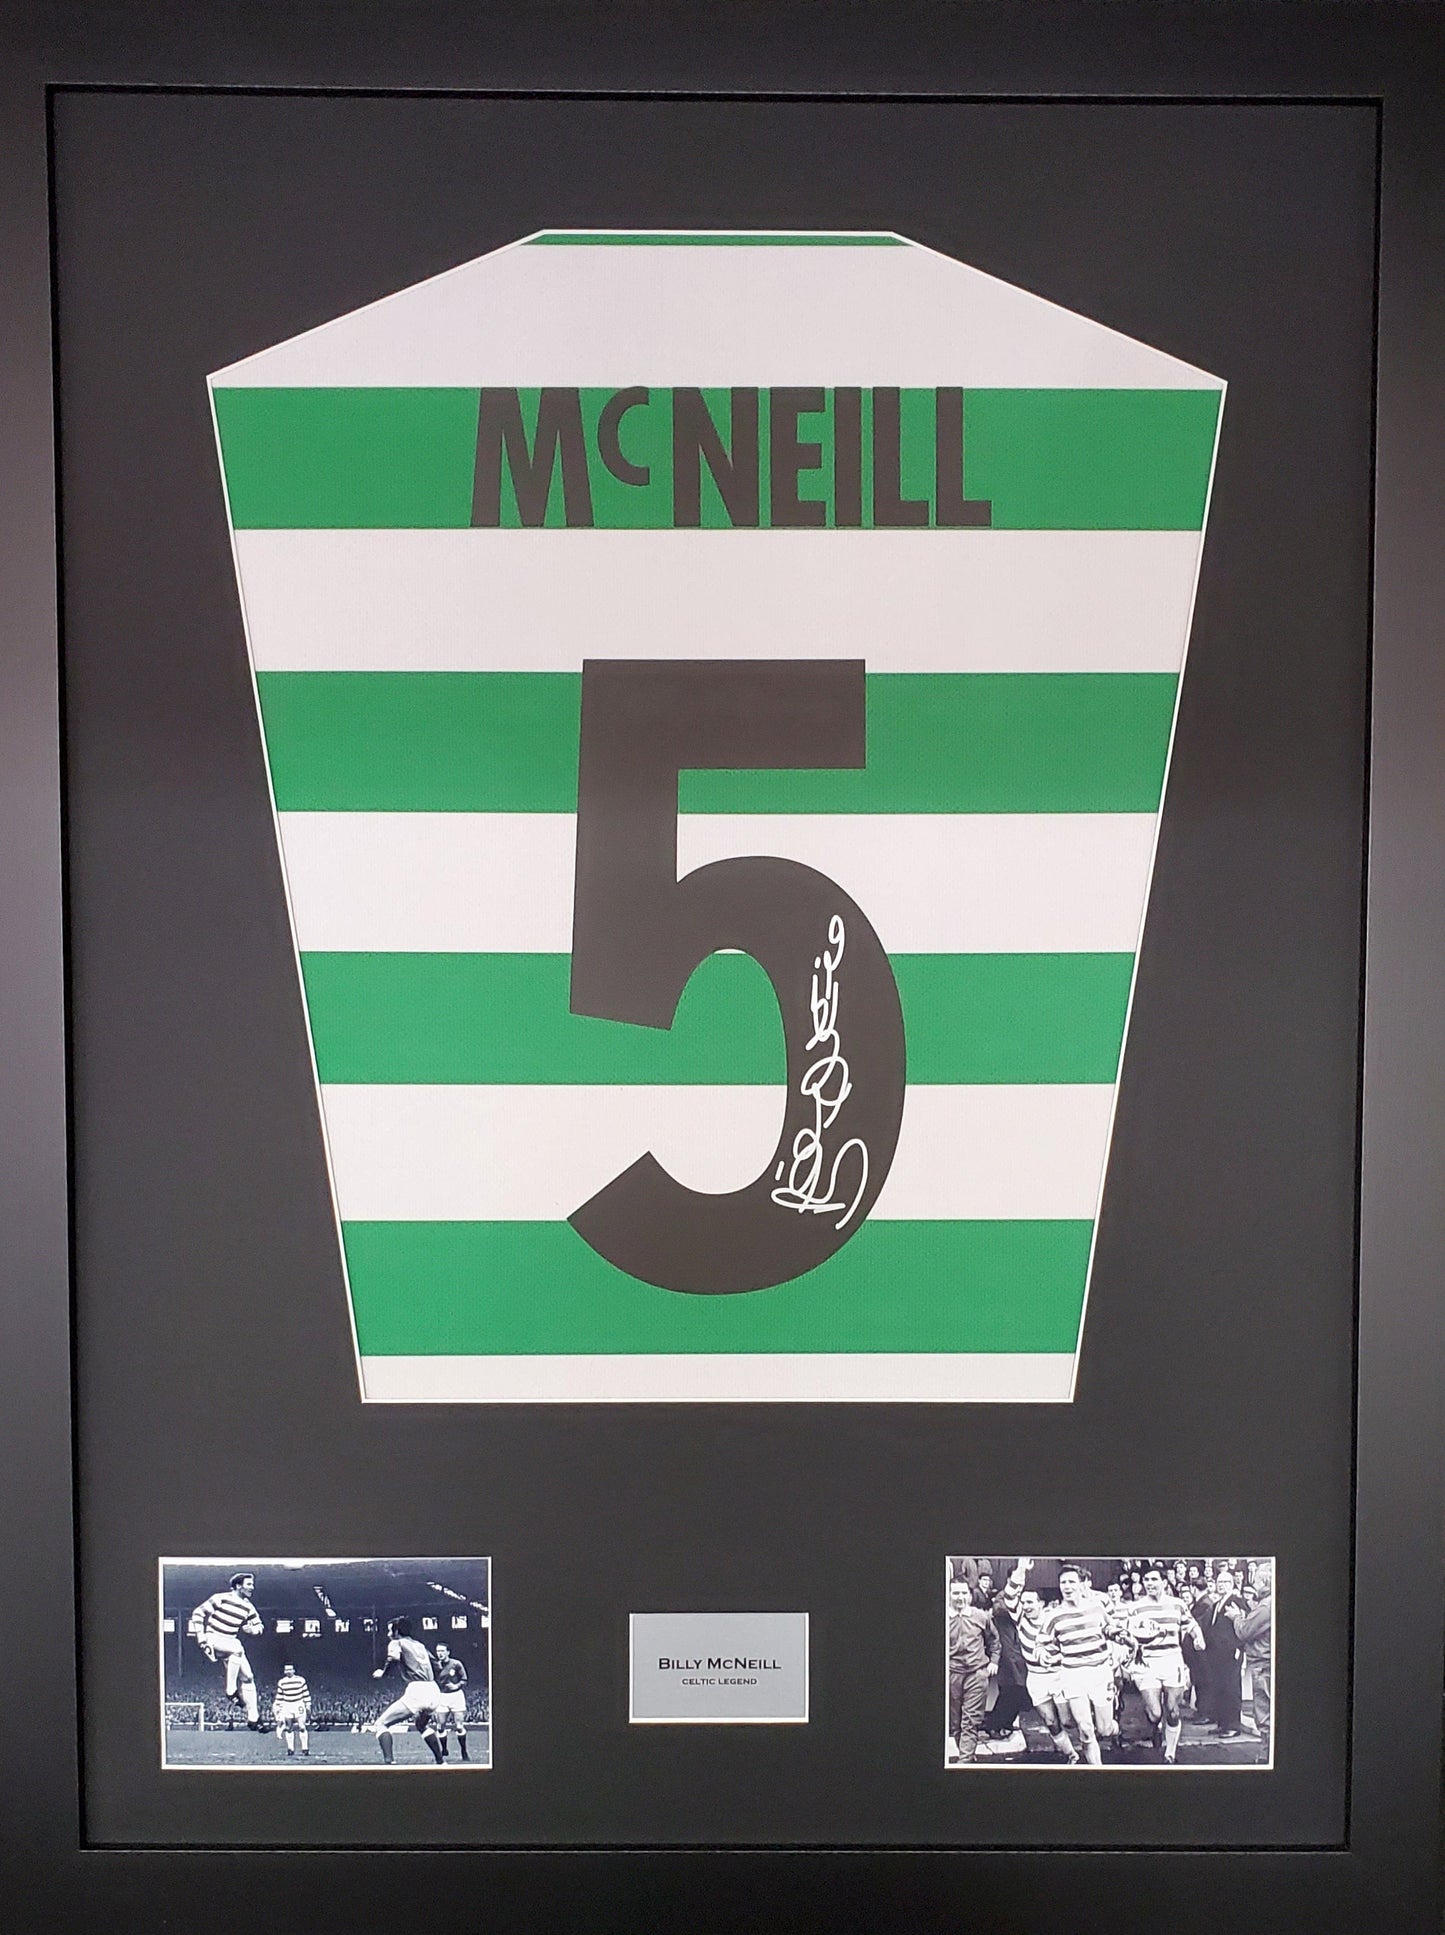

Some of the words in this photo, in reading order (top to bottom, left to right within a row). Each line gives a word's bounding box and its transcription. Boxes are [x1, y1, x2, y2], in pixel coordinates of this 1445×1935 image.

[566, 658, 907, 1297] 5
[682, 1678, 716, 1686] CELTIC
[718, 1678, 758, 1686] LEGEND
